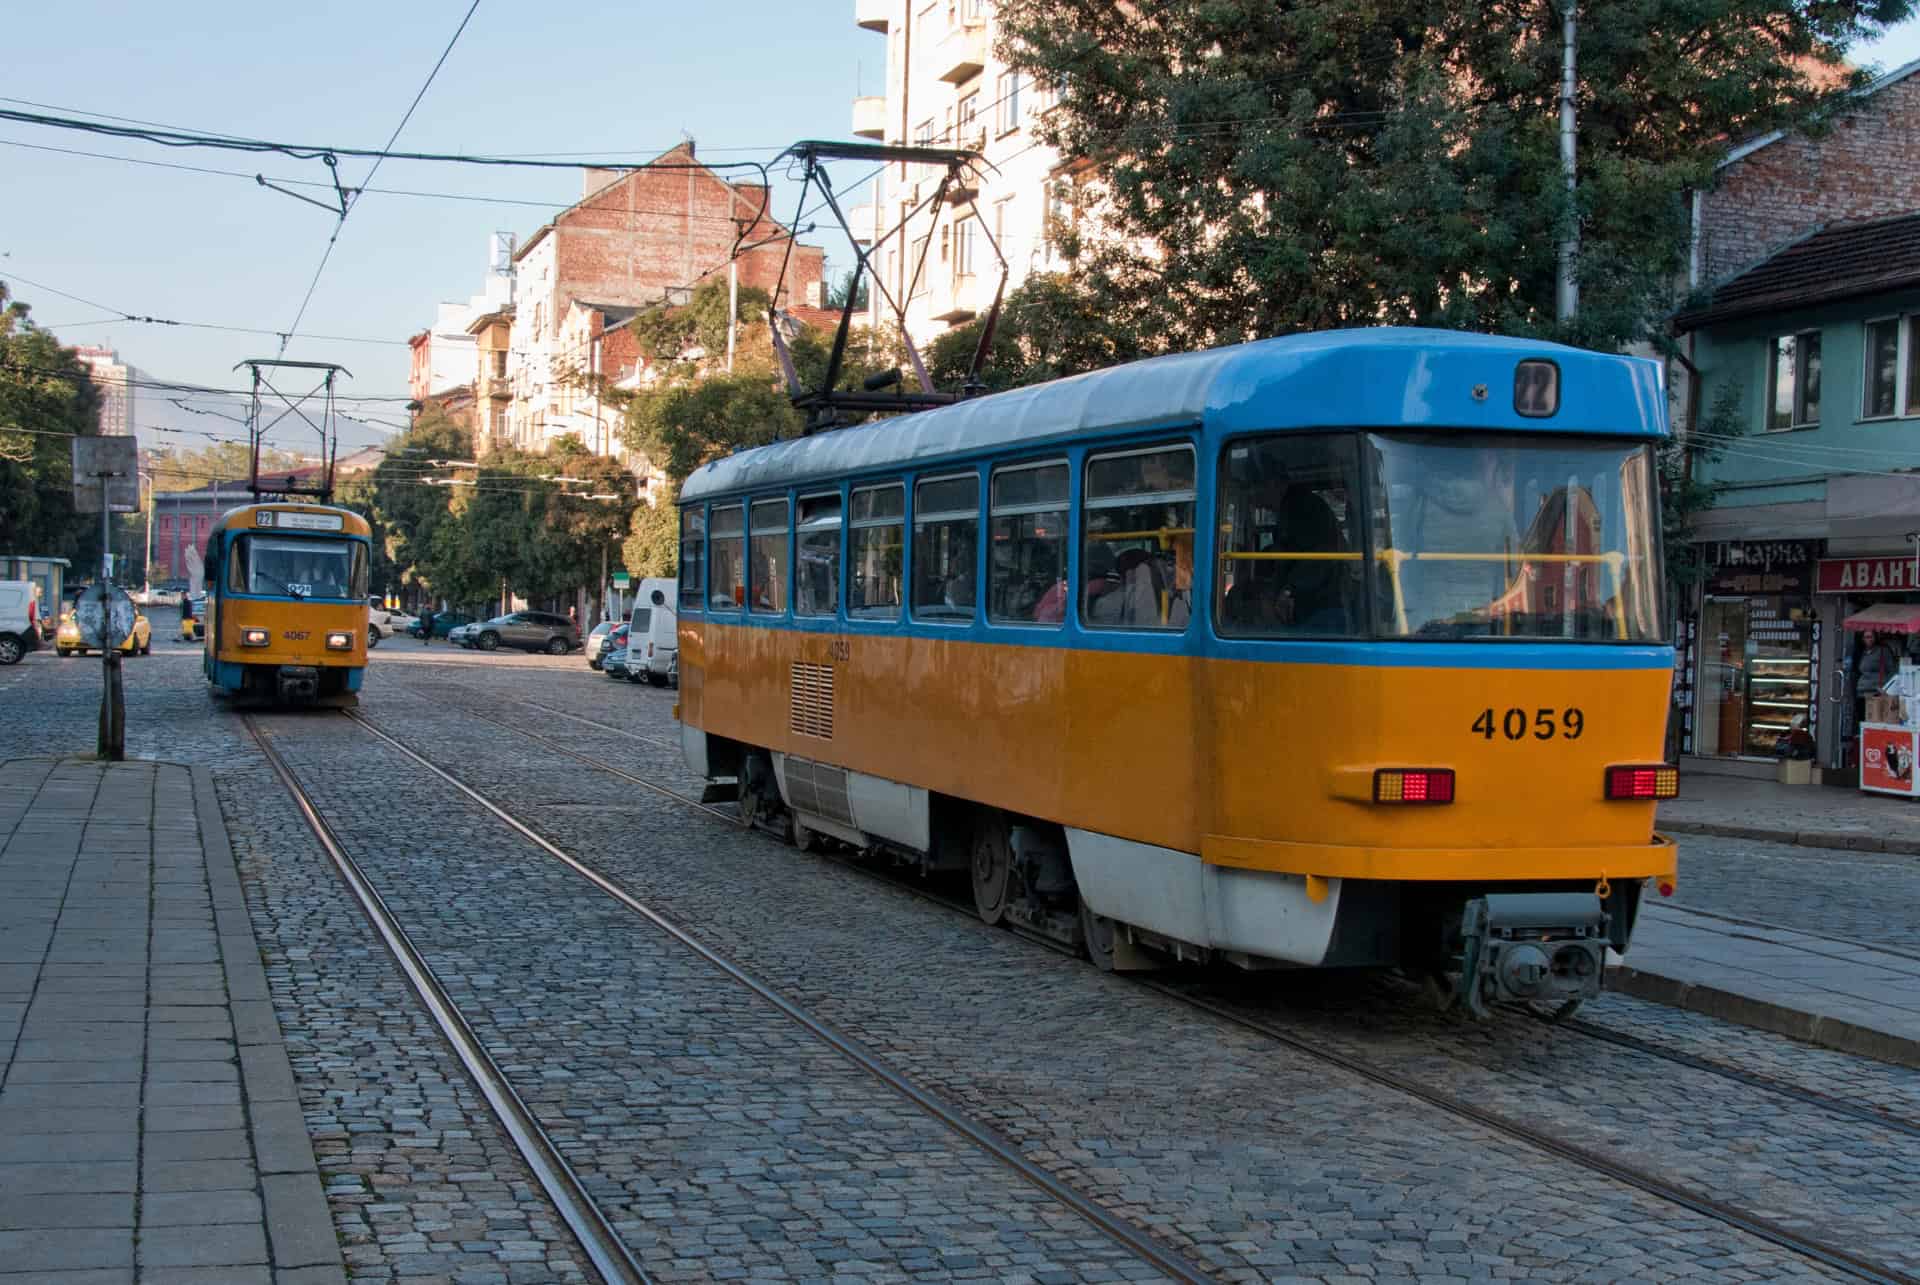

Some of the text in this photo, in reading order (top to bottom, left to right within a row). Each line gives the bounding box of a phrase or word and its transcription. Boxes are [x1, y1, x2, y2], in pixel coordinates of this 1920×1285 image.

[257, 512, 272, 526] 22
[1714, 543, 1807, 573] Пкарна
[1472, 708, 1584, 740] 4059
